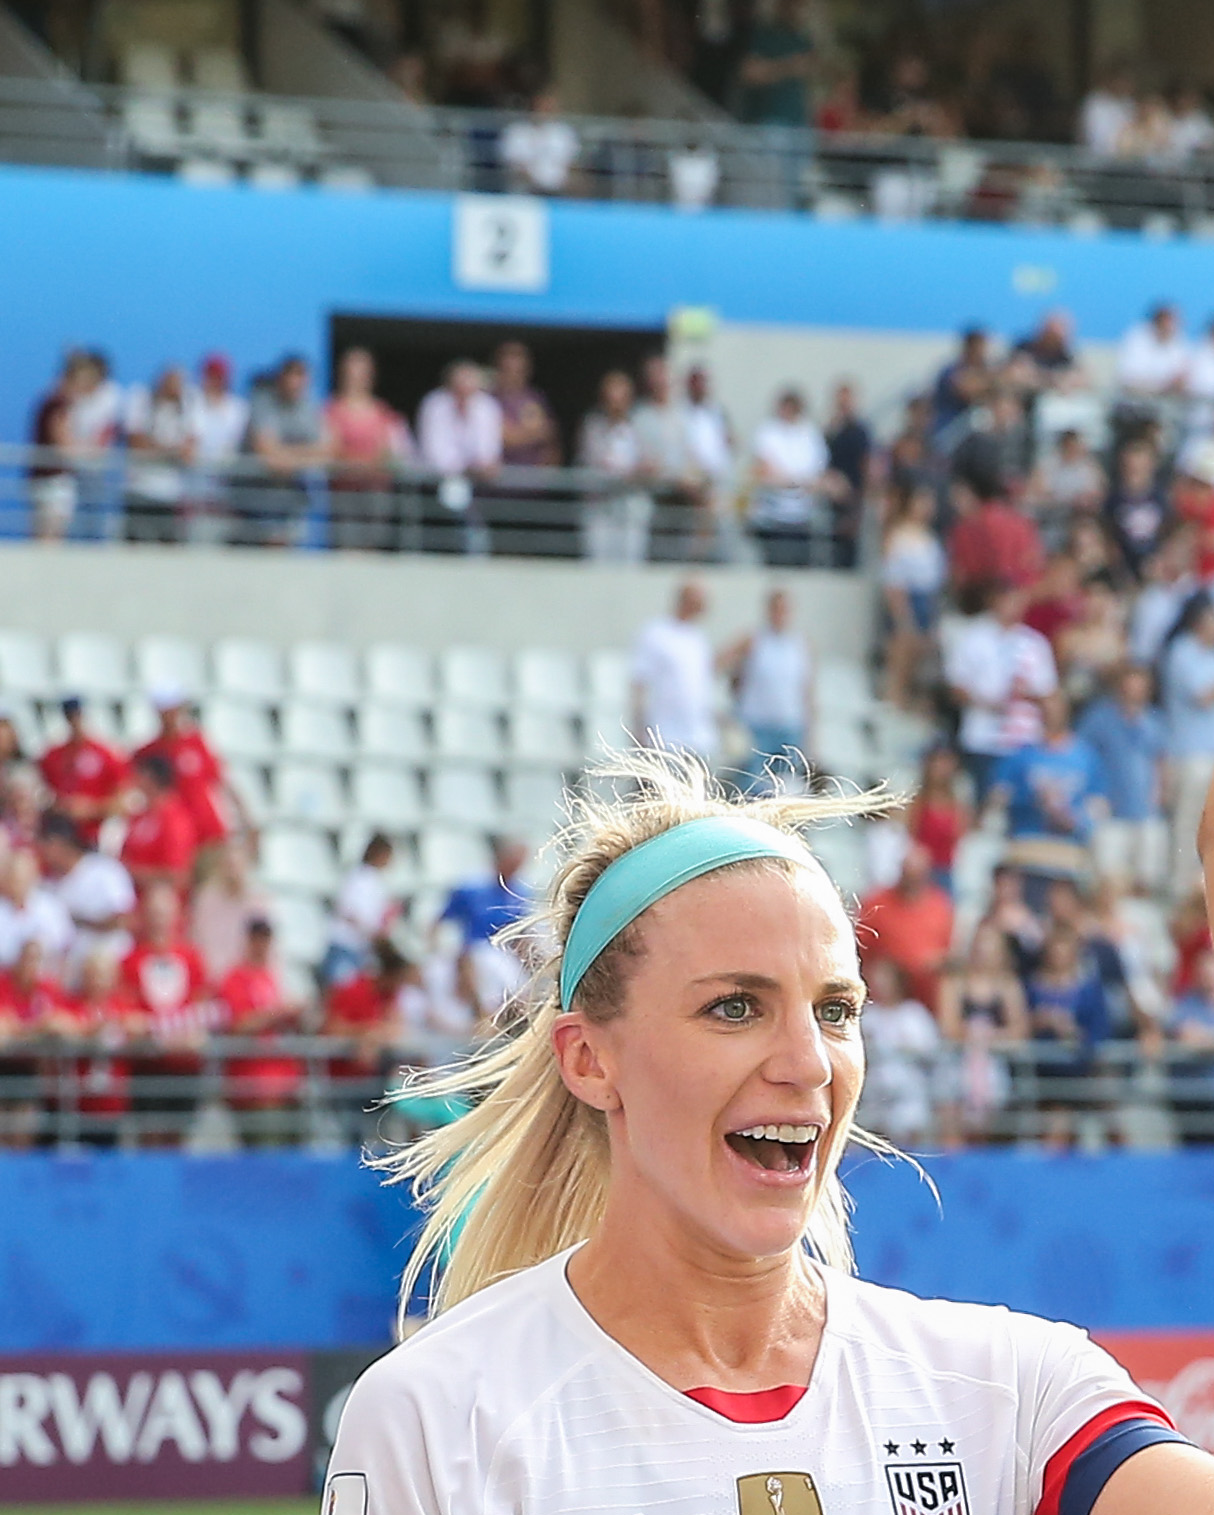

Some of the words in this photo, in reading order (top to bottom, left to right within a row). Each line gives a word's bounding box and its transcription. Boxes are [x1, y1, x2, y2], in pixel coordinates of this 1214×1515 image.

[482, 214, 520, 272] 2
[0, 1367, 307, 1467] RWAYS
[893, 1470, 959, 1511] USA
